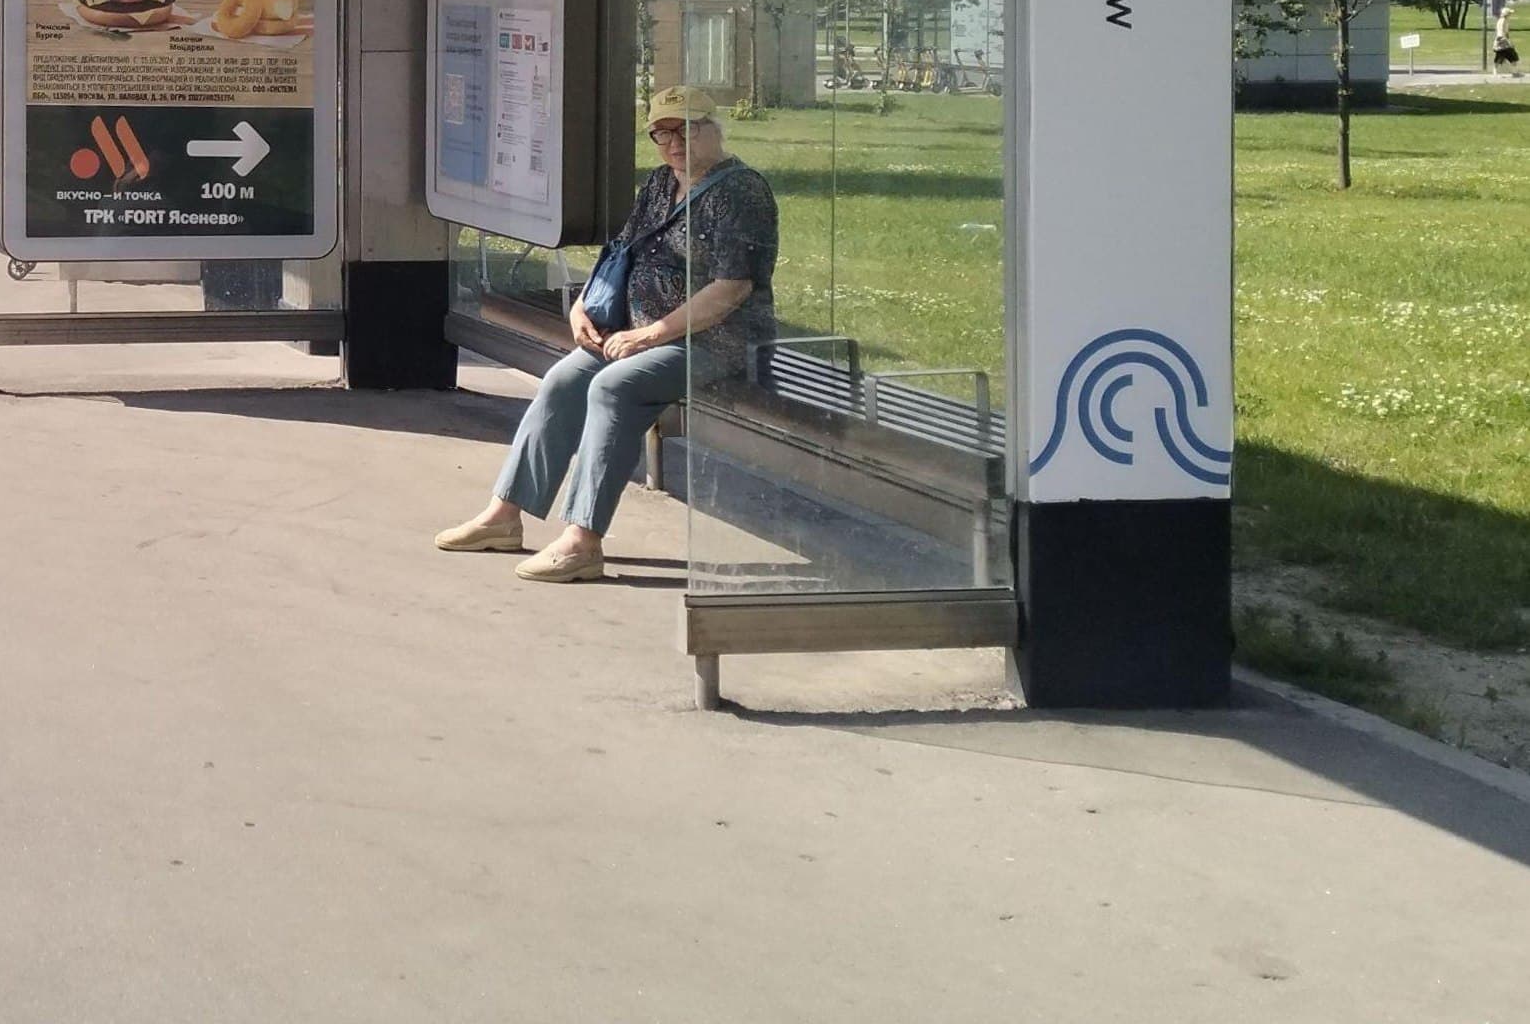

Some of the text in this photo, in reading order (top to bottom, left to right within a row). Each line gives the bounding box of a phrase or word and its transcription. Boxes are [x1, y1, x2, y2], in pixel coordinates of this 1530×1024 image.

[56, 191, 102, 201] ВКУСНО
[124, 191, 162, 201] ТОЧКА
[201, 182, 236, 199] 100
[84, 209, 245, 225] ТРК «FORT Ясенево»
